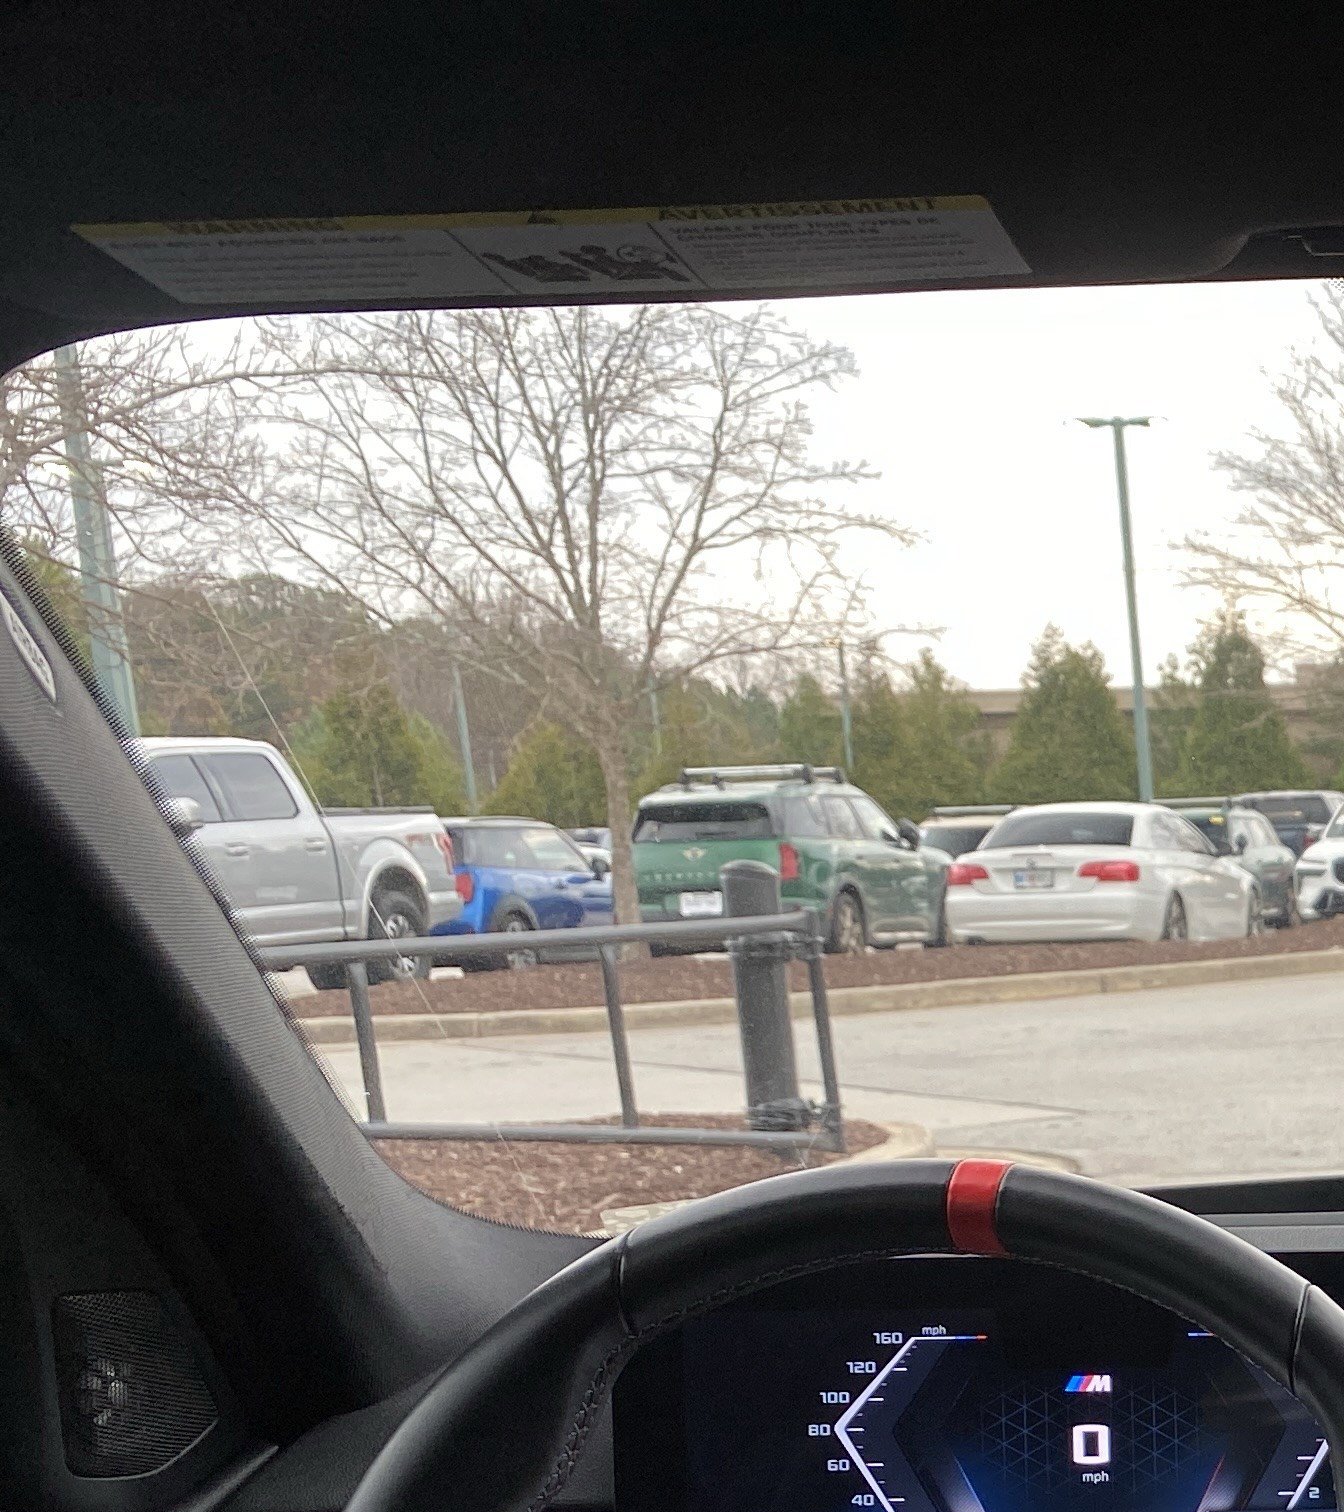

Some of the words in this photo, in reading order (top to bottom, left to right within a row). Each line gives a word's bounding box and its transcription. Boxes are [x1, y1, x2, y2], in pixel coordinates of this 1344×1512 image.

[921, 1325, 947, 1336] mph
[873, 1332, 903, 1344] 160
[846, 1361, 877, 1374] 120
[819, 1391, 850, 1403] 100
[808, 1424, 831, 1436] 80
[1072, 1424, 1110, 1465] 0
[827, 1460, 850, 1472] 60
[1082, 1471, 1110, 1485] mph
[1308, 1486, 1320, 1499] 2
[851, 1494, 875, 1507] 40
